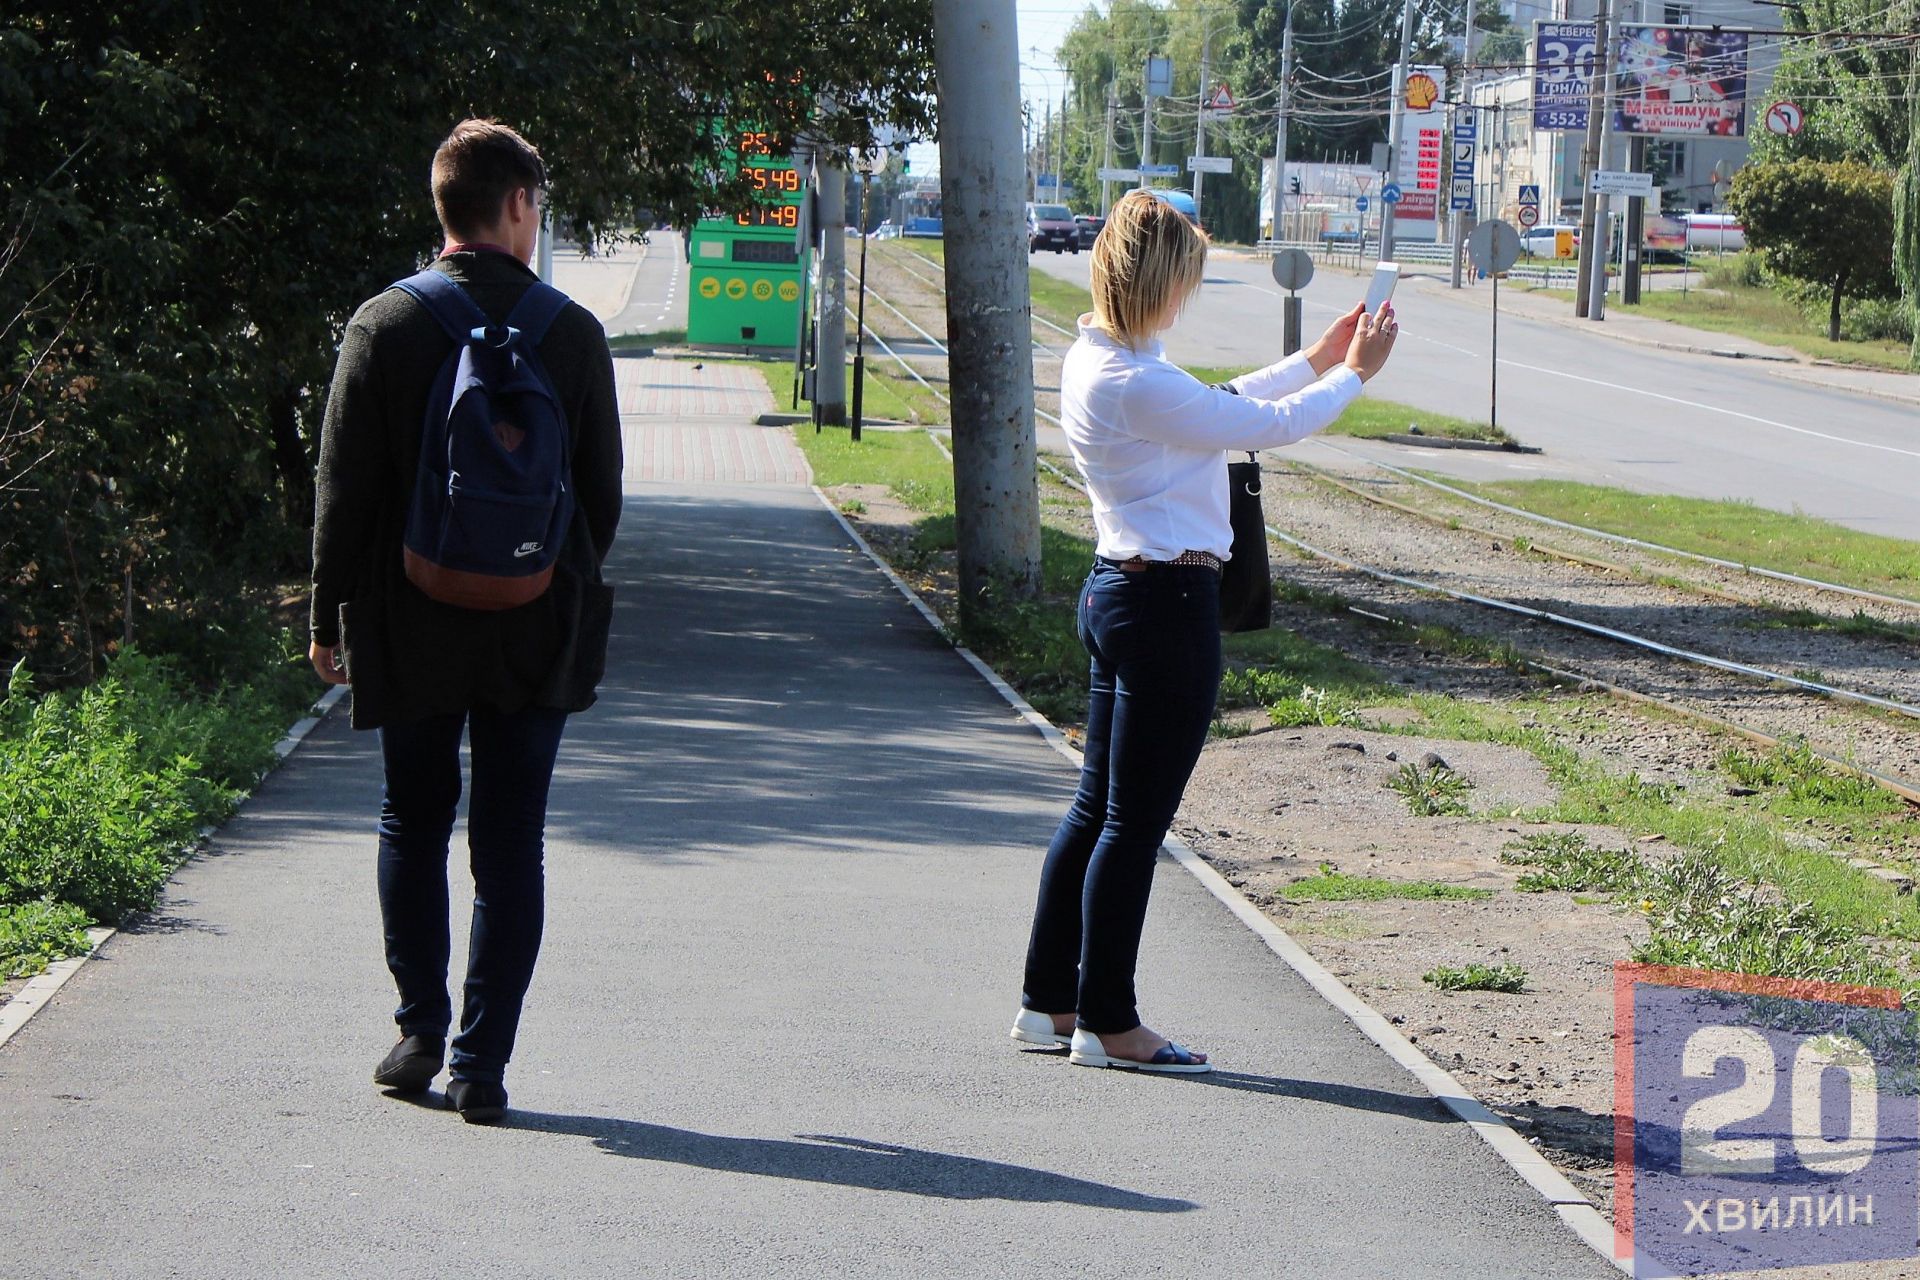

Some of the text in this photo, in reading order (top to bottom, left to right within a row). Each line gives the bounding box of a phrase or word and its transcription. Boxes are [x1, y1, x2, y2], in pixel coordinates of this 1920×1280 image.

[1560, 26, 1597, 37] ЕВЕРЕС
[1542, 80, 1590, 97] грн/м
[1625, 100, 1720, 121] Максимум
[1455, 184, 1470, 193] WC
[1406, 193, 1434, 205] літрів
[781, 288, 797, 296] WC
[521, 542, 538, 550] NIKE
